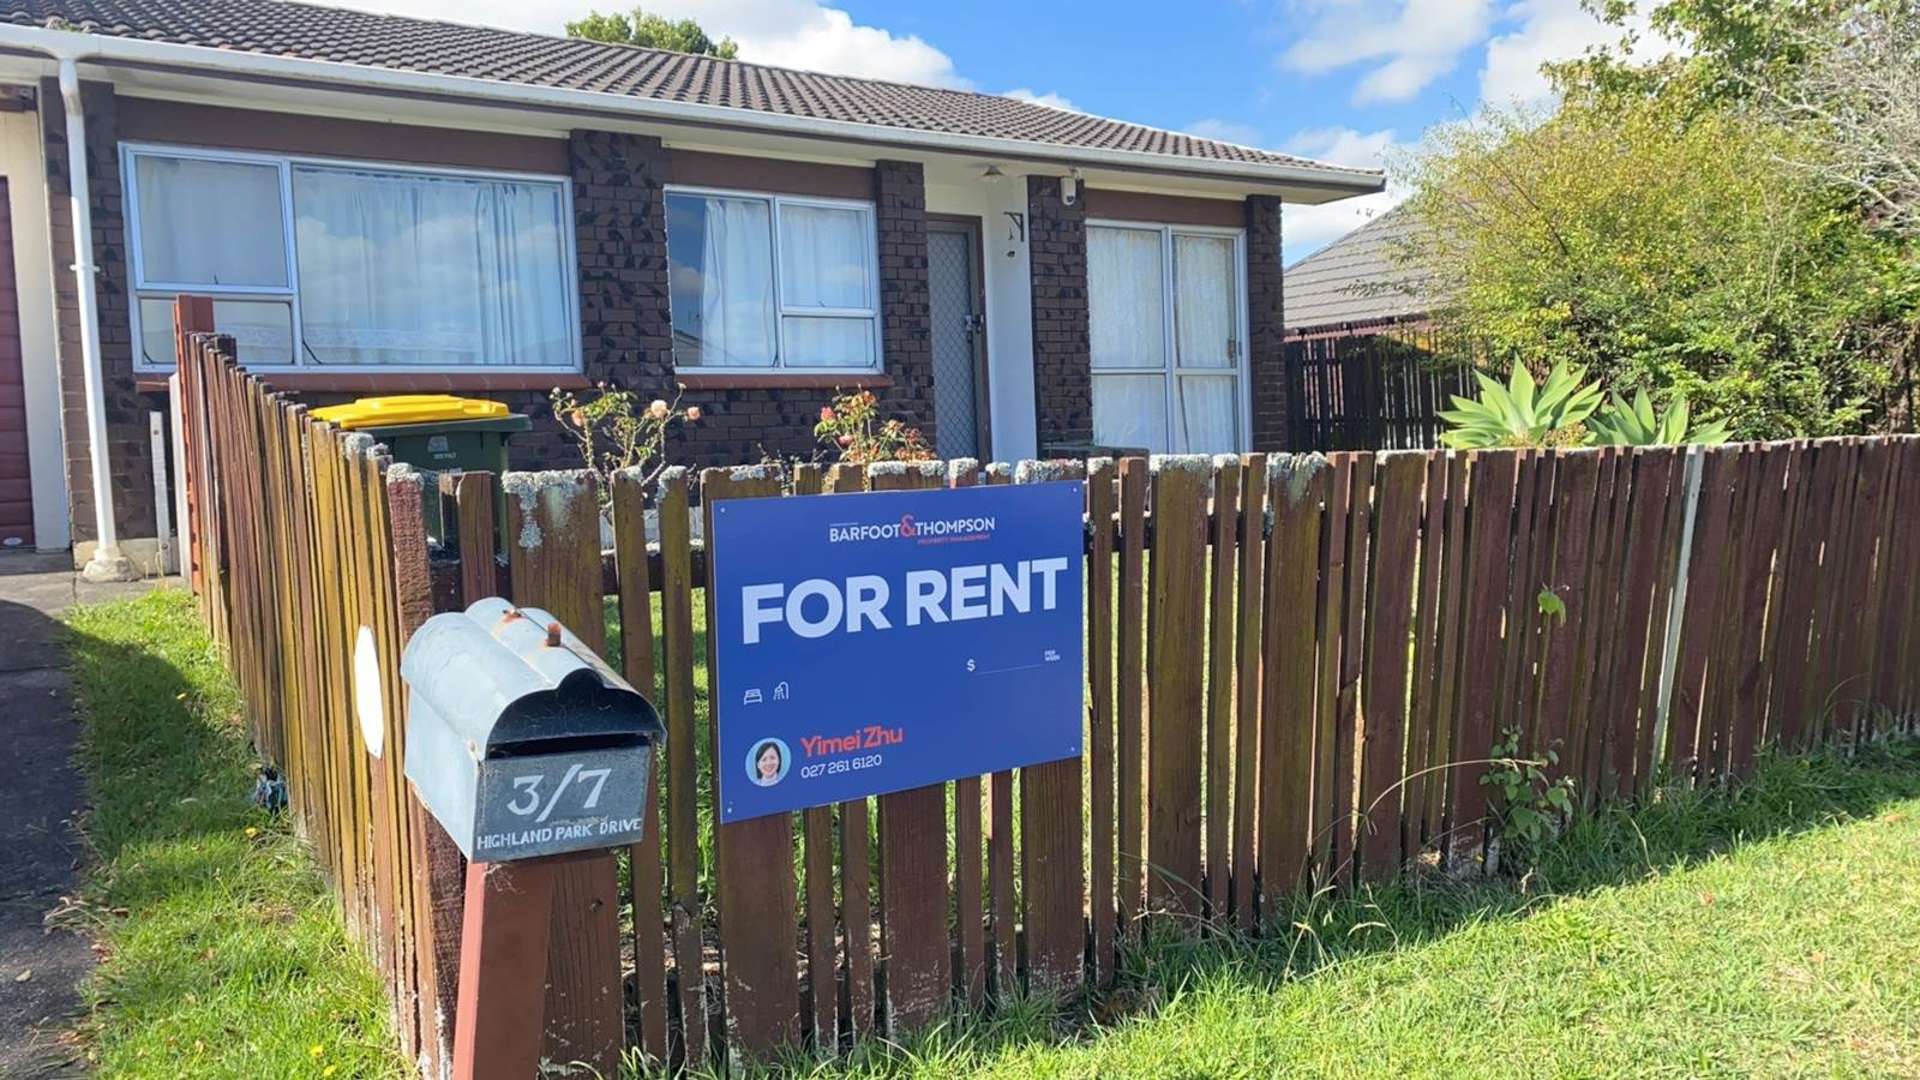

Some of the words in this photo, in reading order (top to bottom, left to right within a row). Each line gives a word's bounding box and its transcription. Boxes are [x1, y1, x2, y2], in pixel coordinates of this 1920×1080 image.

[742, 575, 892, 644] FOR
[906, 557, 1068, 626] RENT
[800, 730, 861, 757] Yimei
[863, 725, 903, 748] Zhu
[800, 764, 826, 778] 027
[827, 760, 850, 775] 261
[852, 754, 882, 770] 6120
[507, 763, 612, 822] 3/7
[477, 828, 552, 850] HIGHLAND
[555, 823, 593, 841] PARK
[600, 818, 642, 835] DRIVE
